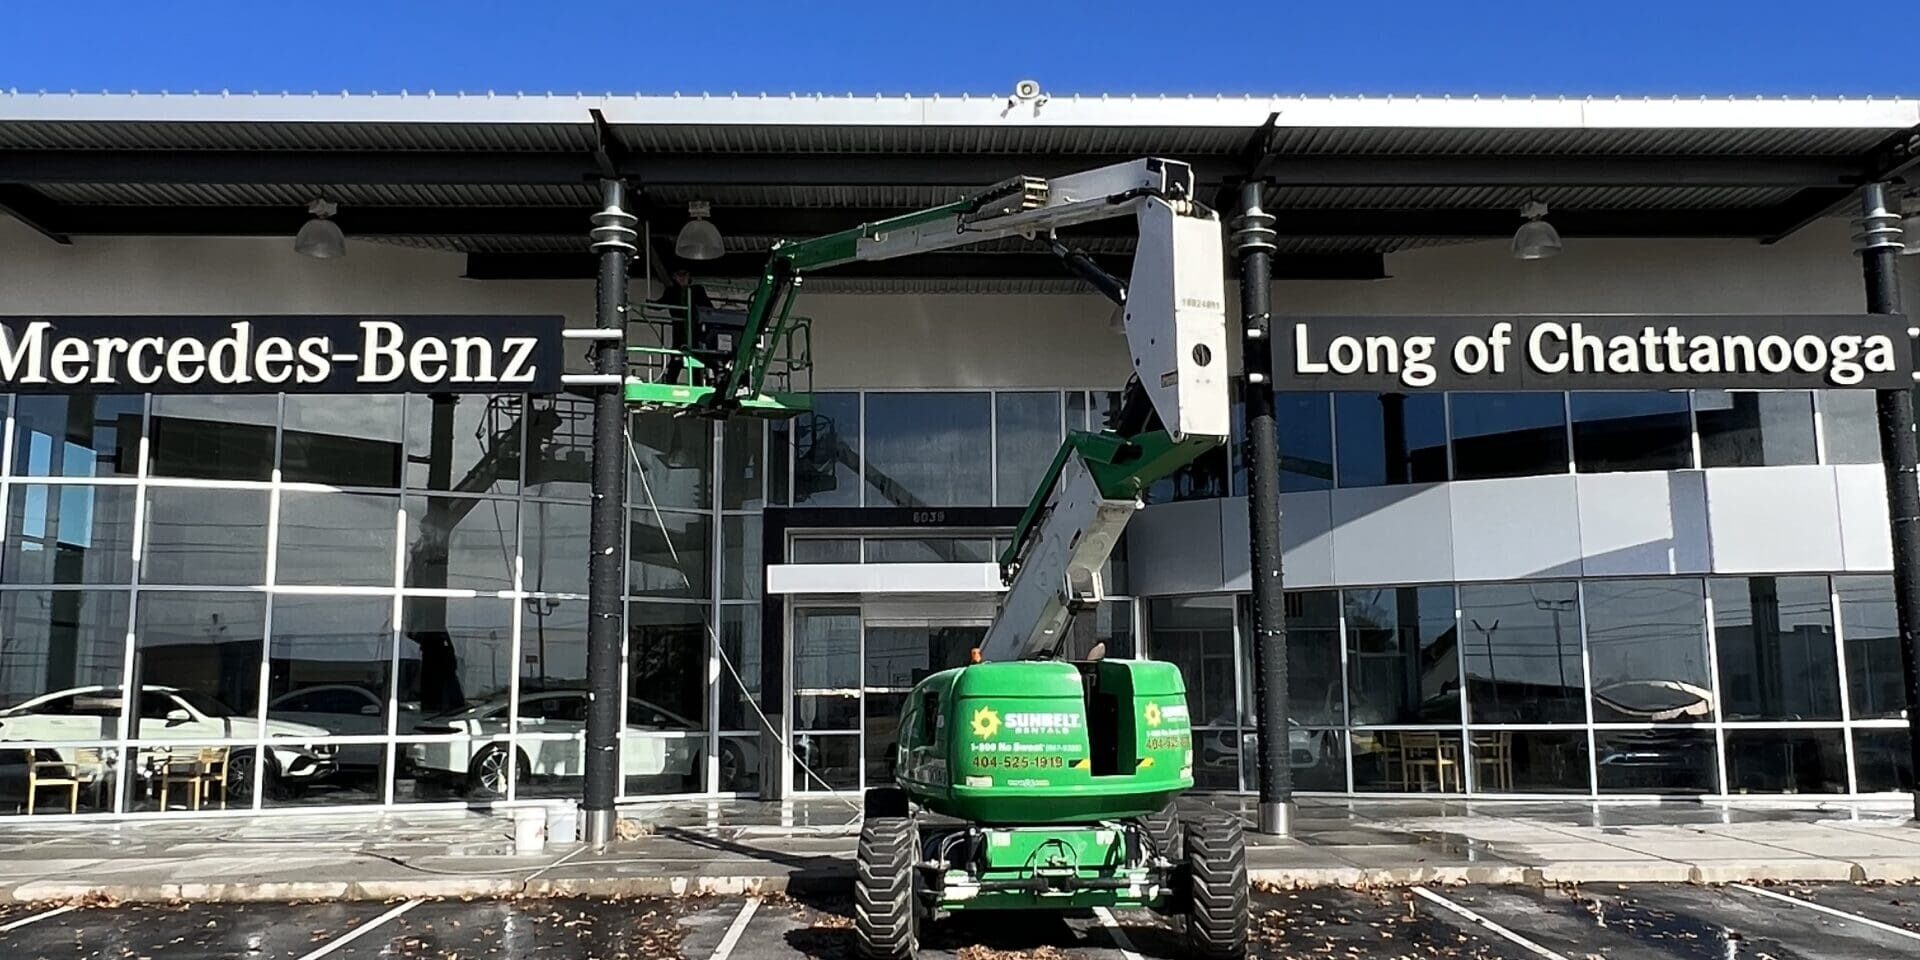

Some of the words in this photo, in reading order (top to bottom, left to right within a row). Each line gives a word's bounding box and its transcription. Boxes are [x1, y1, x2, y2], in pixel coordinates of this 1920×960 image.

[0, 321, 537, 384] Mercedes-Benz
[1295, 323, 1437, 387] Long
[1454, 323, 1513, 374] of
[1528, 322, 1896, 384] Chattanooga
[1004, 713, 1081, 728] SUNBELT
[972, 756, 1063, 769] 404-525-1919
